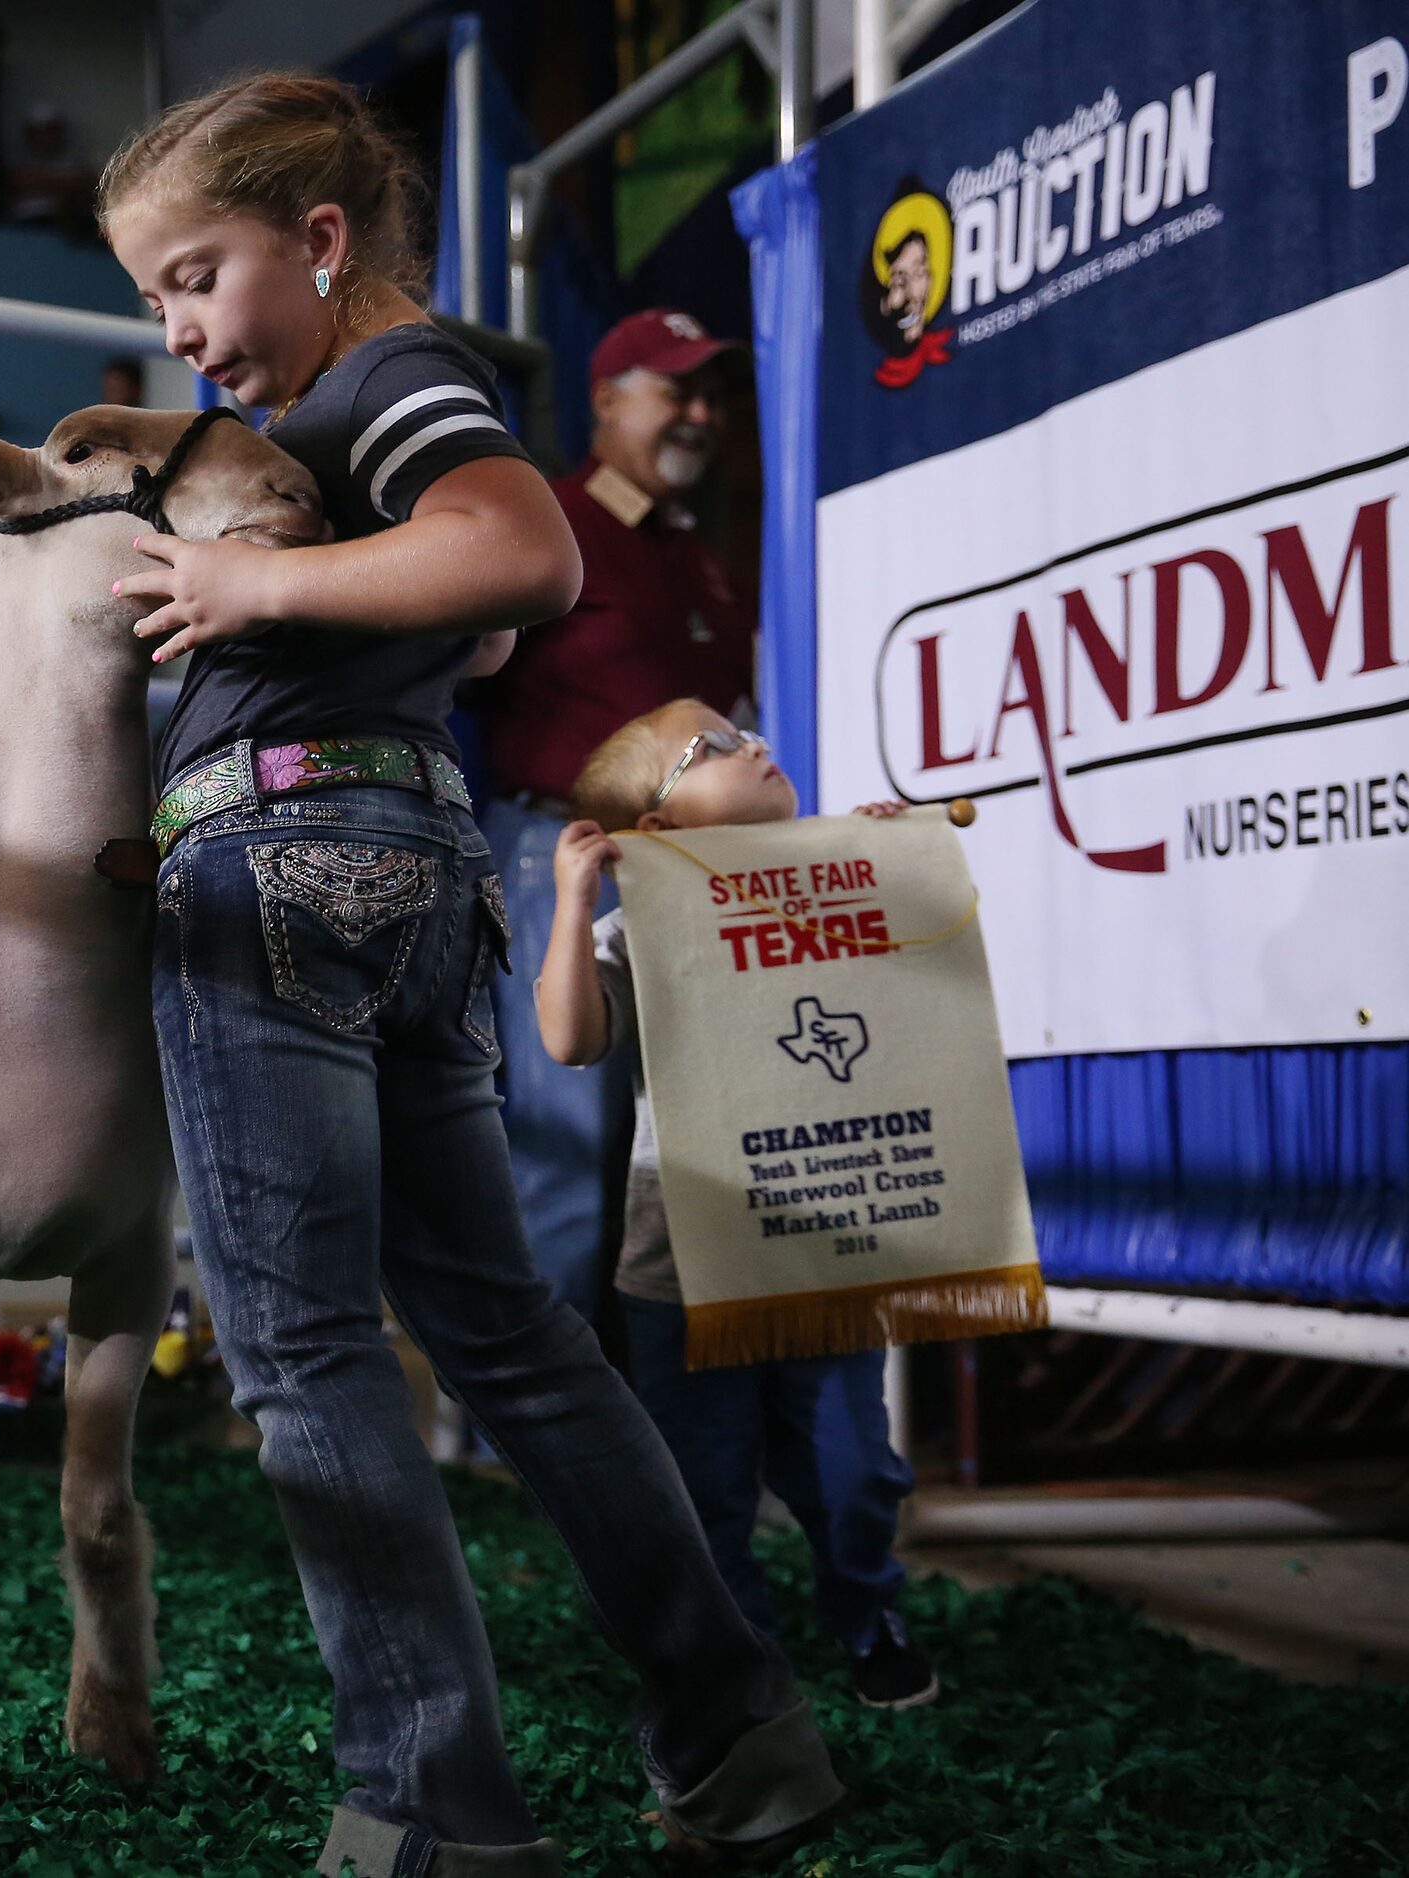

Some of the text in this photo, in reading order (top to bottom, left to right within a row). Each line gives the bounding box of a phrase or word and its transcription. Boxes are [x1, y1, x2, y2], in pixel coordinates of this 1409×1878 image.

[950, 70, 1217, 316] AUCTION
[958, 303, 1019, 346] HOSTED
[1017, 294, 1040, 322] BY
[1056, 256, 1104, 298] STATE
[1102, 240, 1141, 277] FAIR
[1138, 226, 1165, 259] OF
[911, 492, 1409, 872] LANDM
[1184, 772, 1409, 861] NURSERIES
[708, 859, 877, 905] STATE FAIR
[783, 898, 812, 917] OF
[719, 909, 891, 972] TEXAS
[742, 1108, 932, 1157] CHAMPION
[749, 1145, 934, 1182] Youth Livestock Show
[747, 1169, 945, 1210] Finewool Cross
[760, 1197, 940, 1238] Market Lamb
[833, 1235, 878, 1255] 2016
